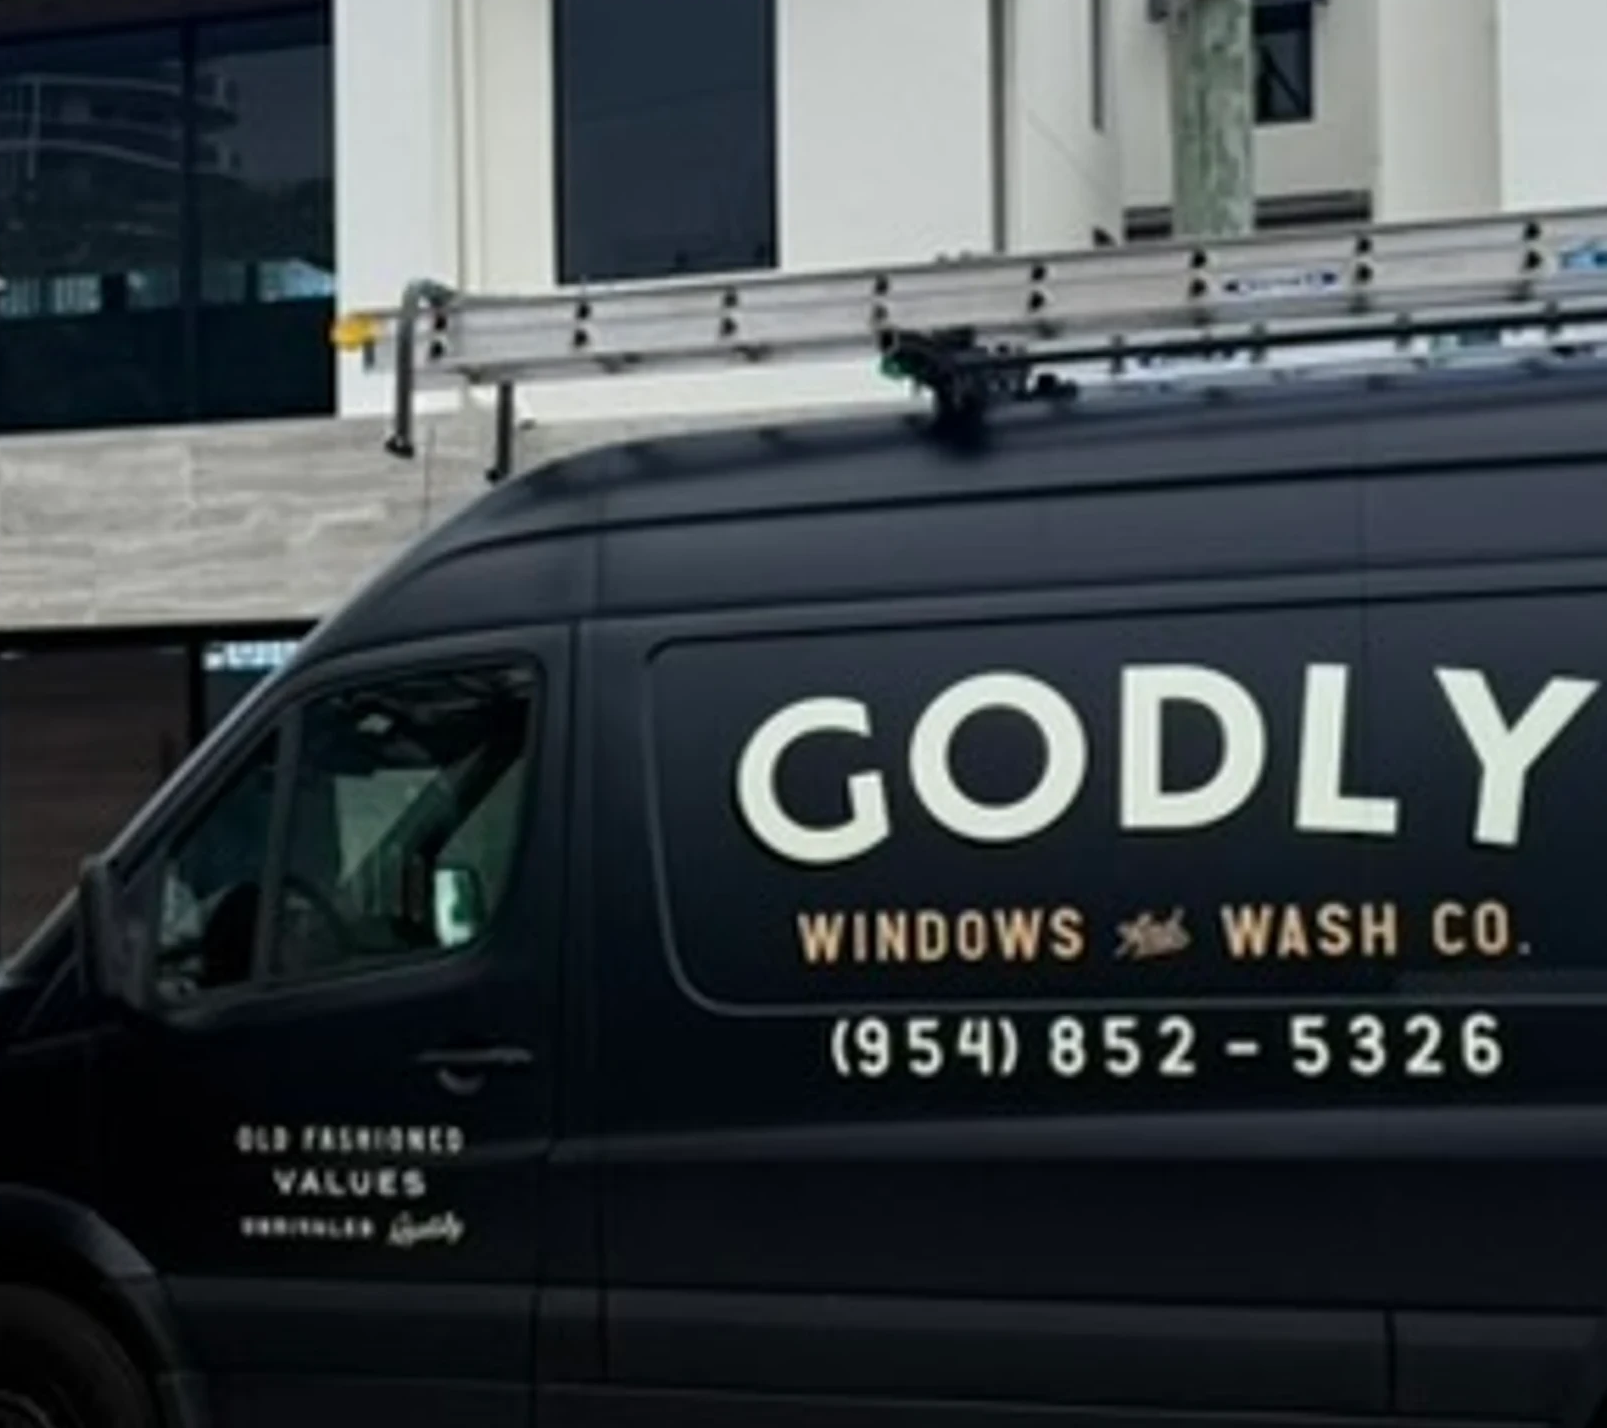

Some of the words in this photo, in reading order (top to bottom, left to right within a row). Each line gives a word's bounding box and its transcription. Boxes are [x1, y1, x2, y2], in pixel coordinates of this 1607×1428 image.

[738, 663, 1599, 863] GODLY
[796, 906, 1085, 963] WINDOWS
[1220, 902, 1397, 958] WASH
[1432, 900, 1531, 957] CO.
[830, 1016, 1019, 1078] (954)
[1048, 1014, 1197, 1077] 852
[1289, 1012, 1503, 1077] 5326
[236, 1125, 290, 1153] OLD
[301, 1125, 464, 1155] FASHIONED
[272, 1167, 427, 1198] VALUES
